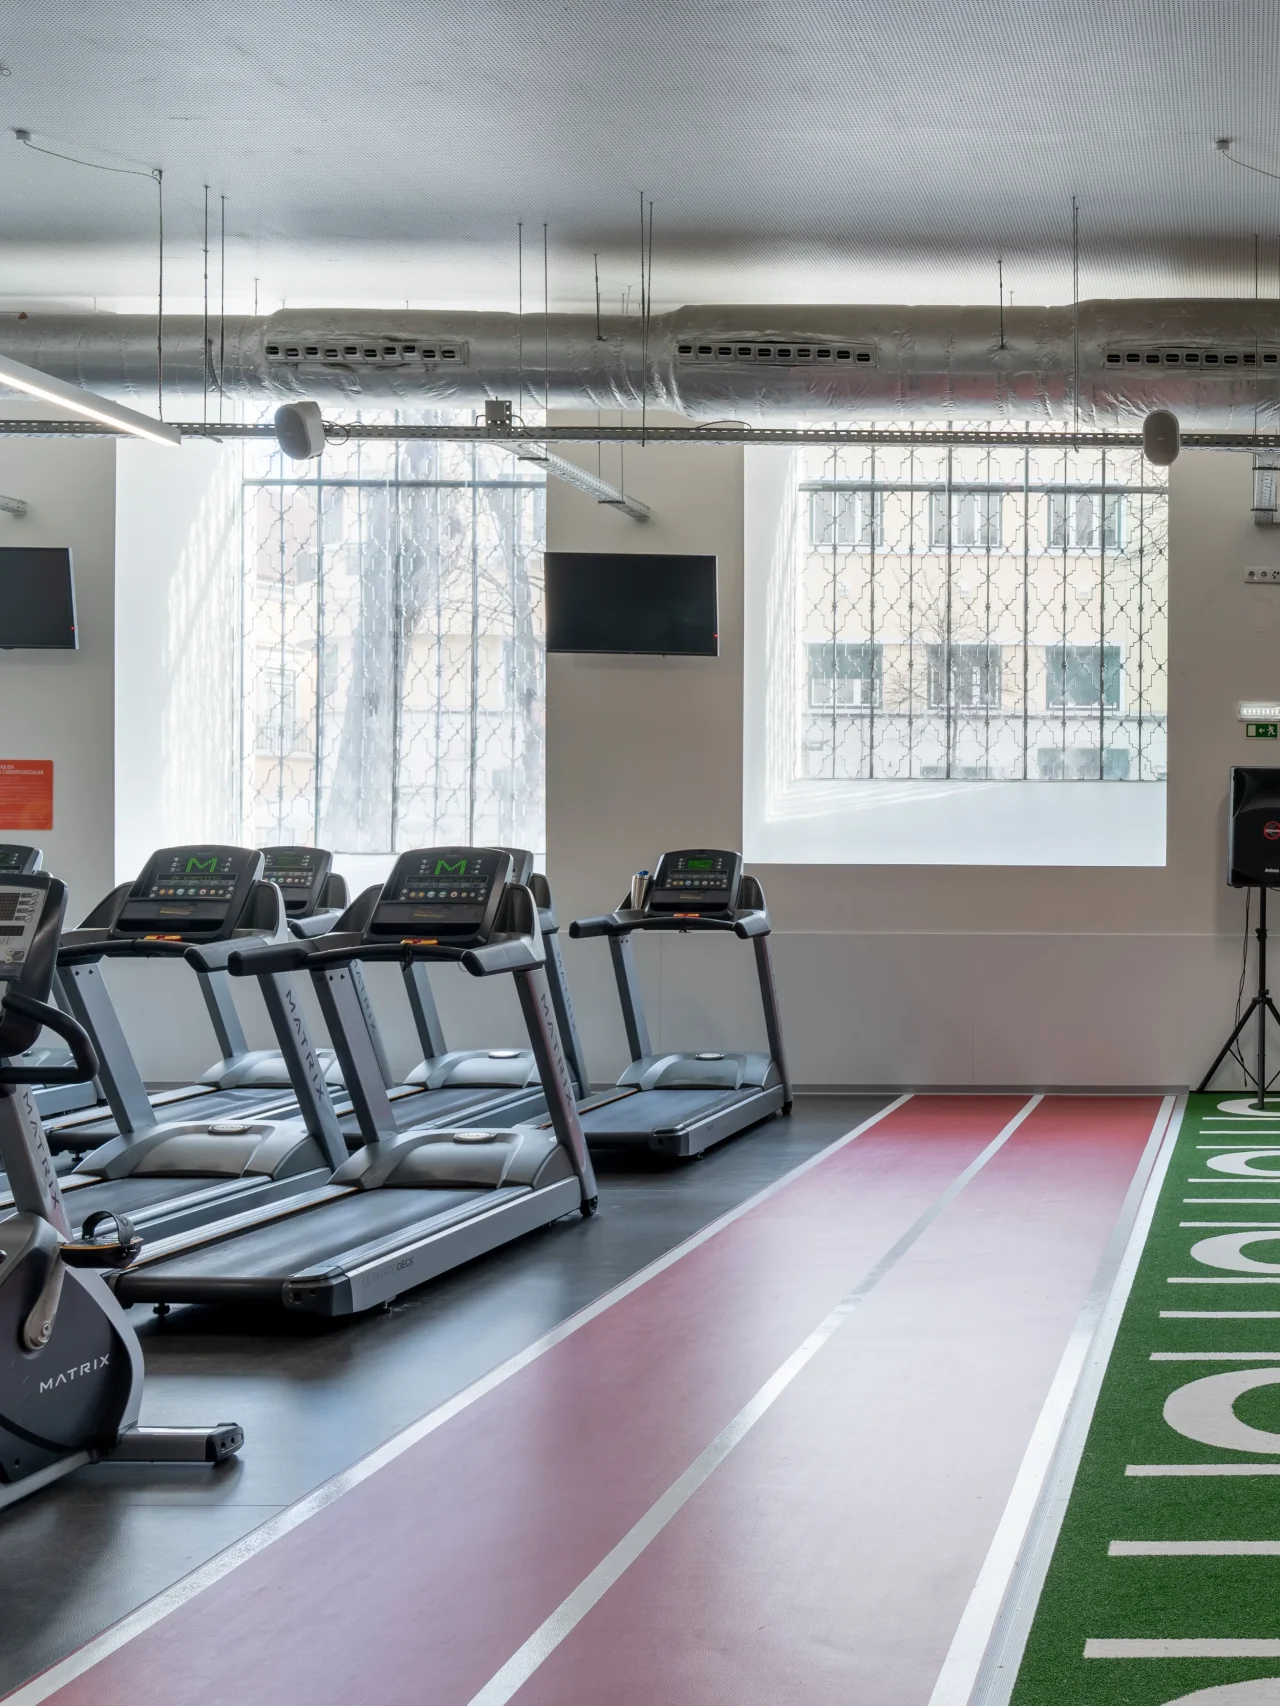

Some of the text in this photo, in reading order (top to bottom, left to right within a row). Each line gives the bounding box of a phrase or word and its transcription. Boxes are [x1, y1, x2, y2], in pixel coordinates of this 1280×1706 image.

[286, 990, 325, 1101] MATRIX
[541, 993, 573, 1108] MATRIX
[23, 1091, 60, 1208] MATRIX
[396, 1255, 416, 1271] DECK
[39, 1353, 110, 1394] MATRIX
